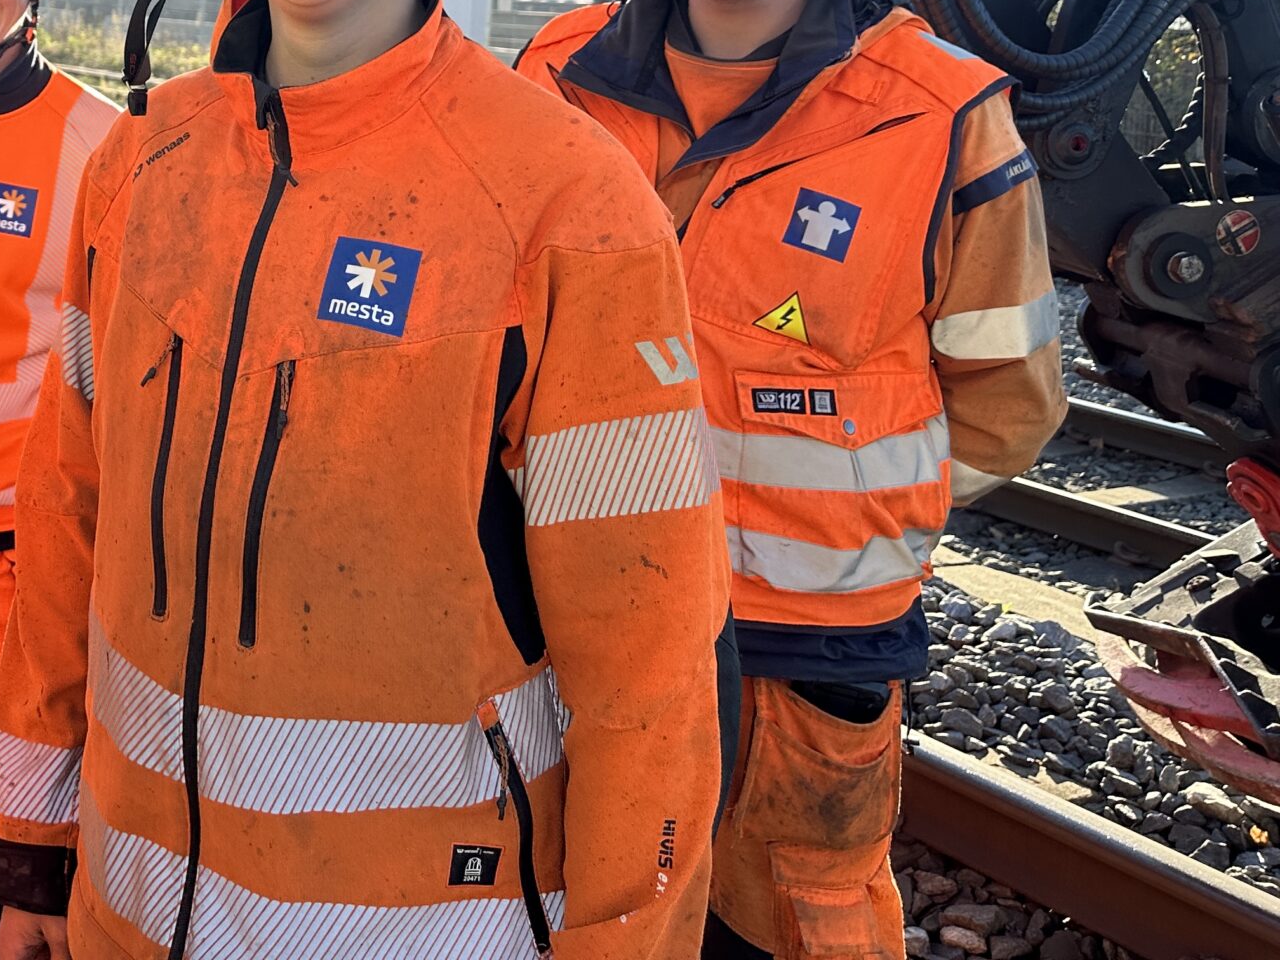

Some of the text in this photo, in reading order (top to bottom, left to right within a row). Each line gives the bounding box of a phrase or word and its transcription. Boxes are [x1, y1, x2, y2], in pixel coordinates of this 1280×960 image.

[145, 131, 191, 166] wenaas
[328, 298, 394, 326] mesta
[778, 392, 800, 410] 112
[658, 819, 677, 870] HIVIS
